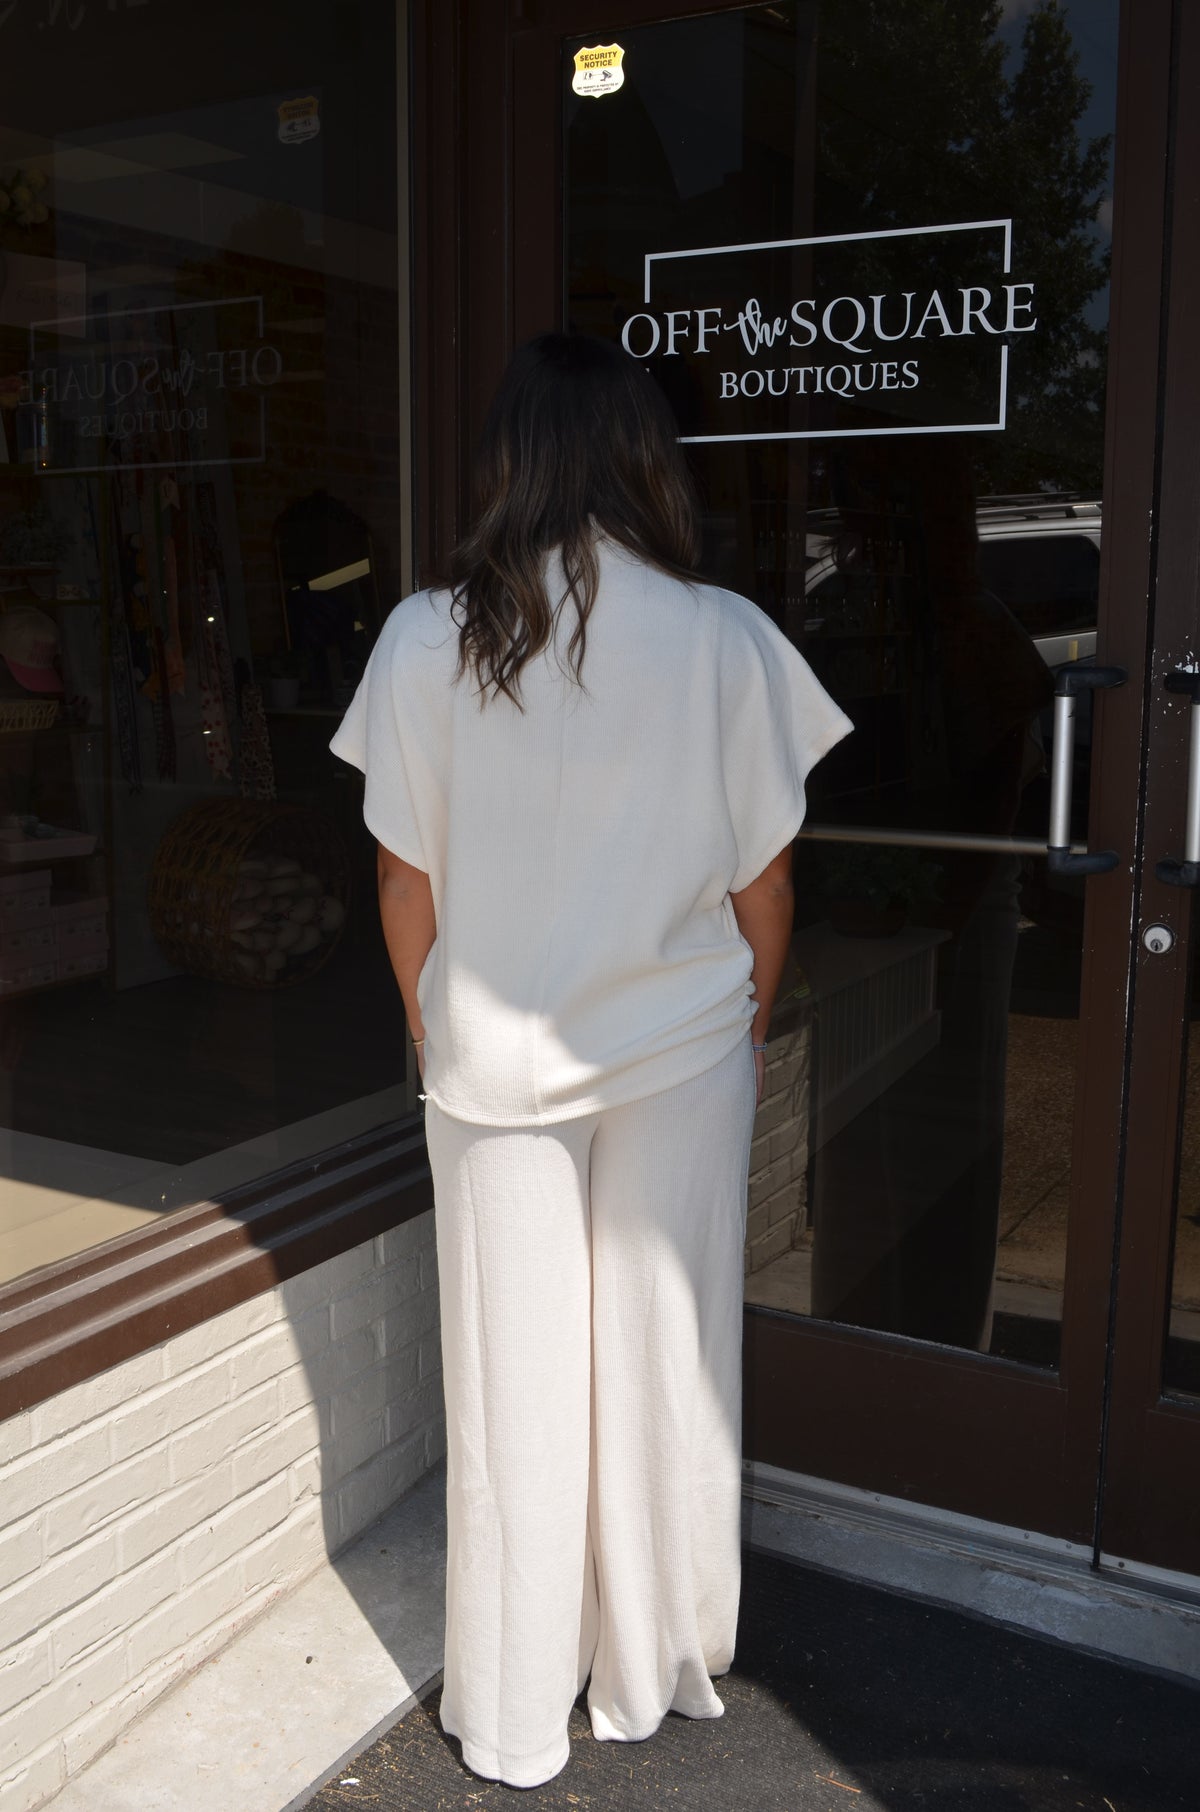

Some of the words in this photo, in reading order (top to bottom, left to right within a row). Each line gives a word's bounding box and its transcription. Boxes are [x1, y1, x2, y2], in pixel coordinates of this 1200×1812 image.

[580, 51, 618, 62] SECURITY
[584, 59, 612, 69] NOTICE
[621, 307, 722, 358] OFF
[723, 298, 788, 356] the
[789, 283, 1038, 353] SQUARE
[719, 360, 920, 399] BOUTIQUES
